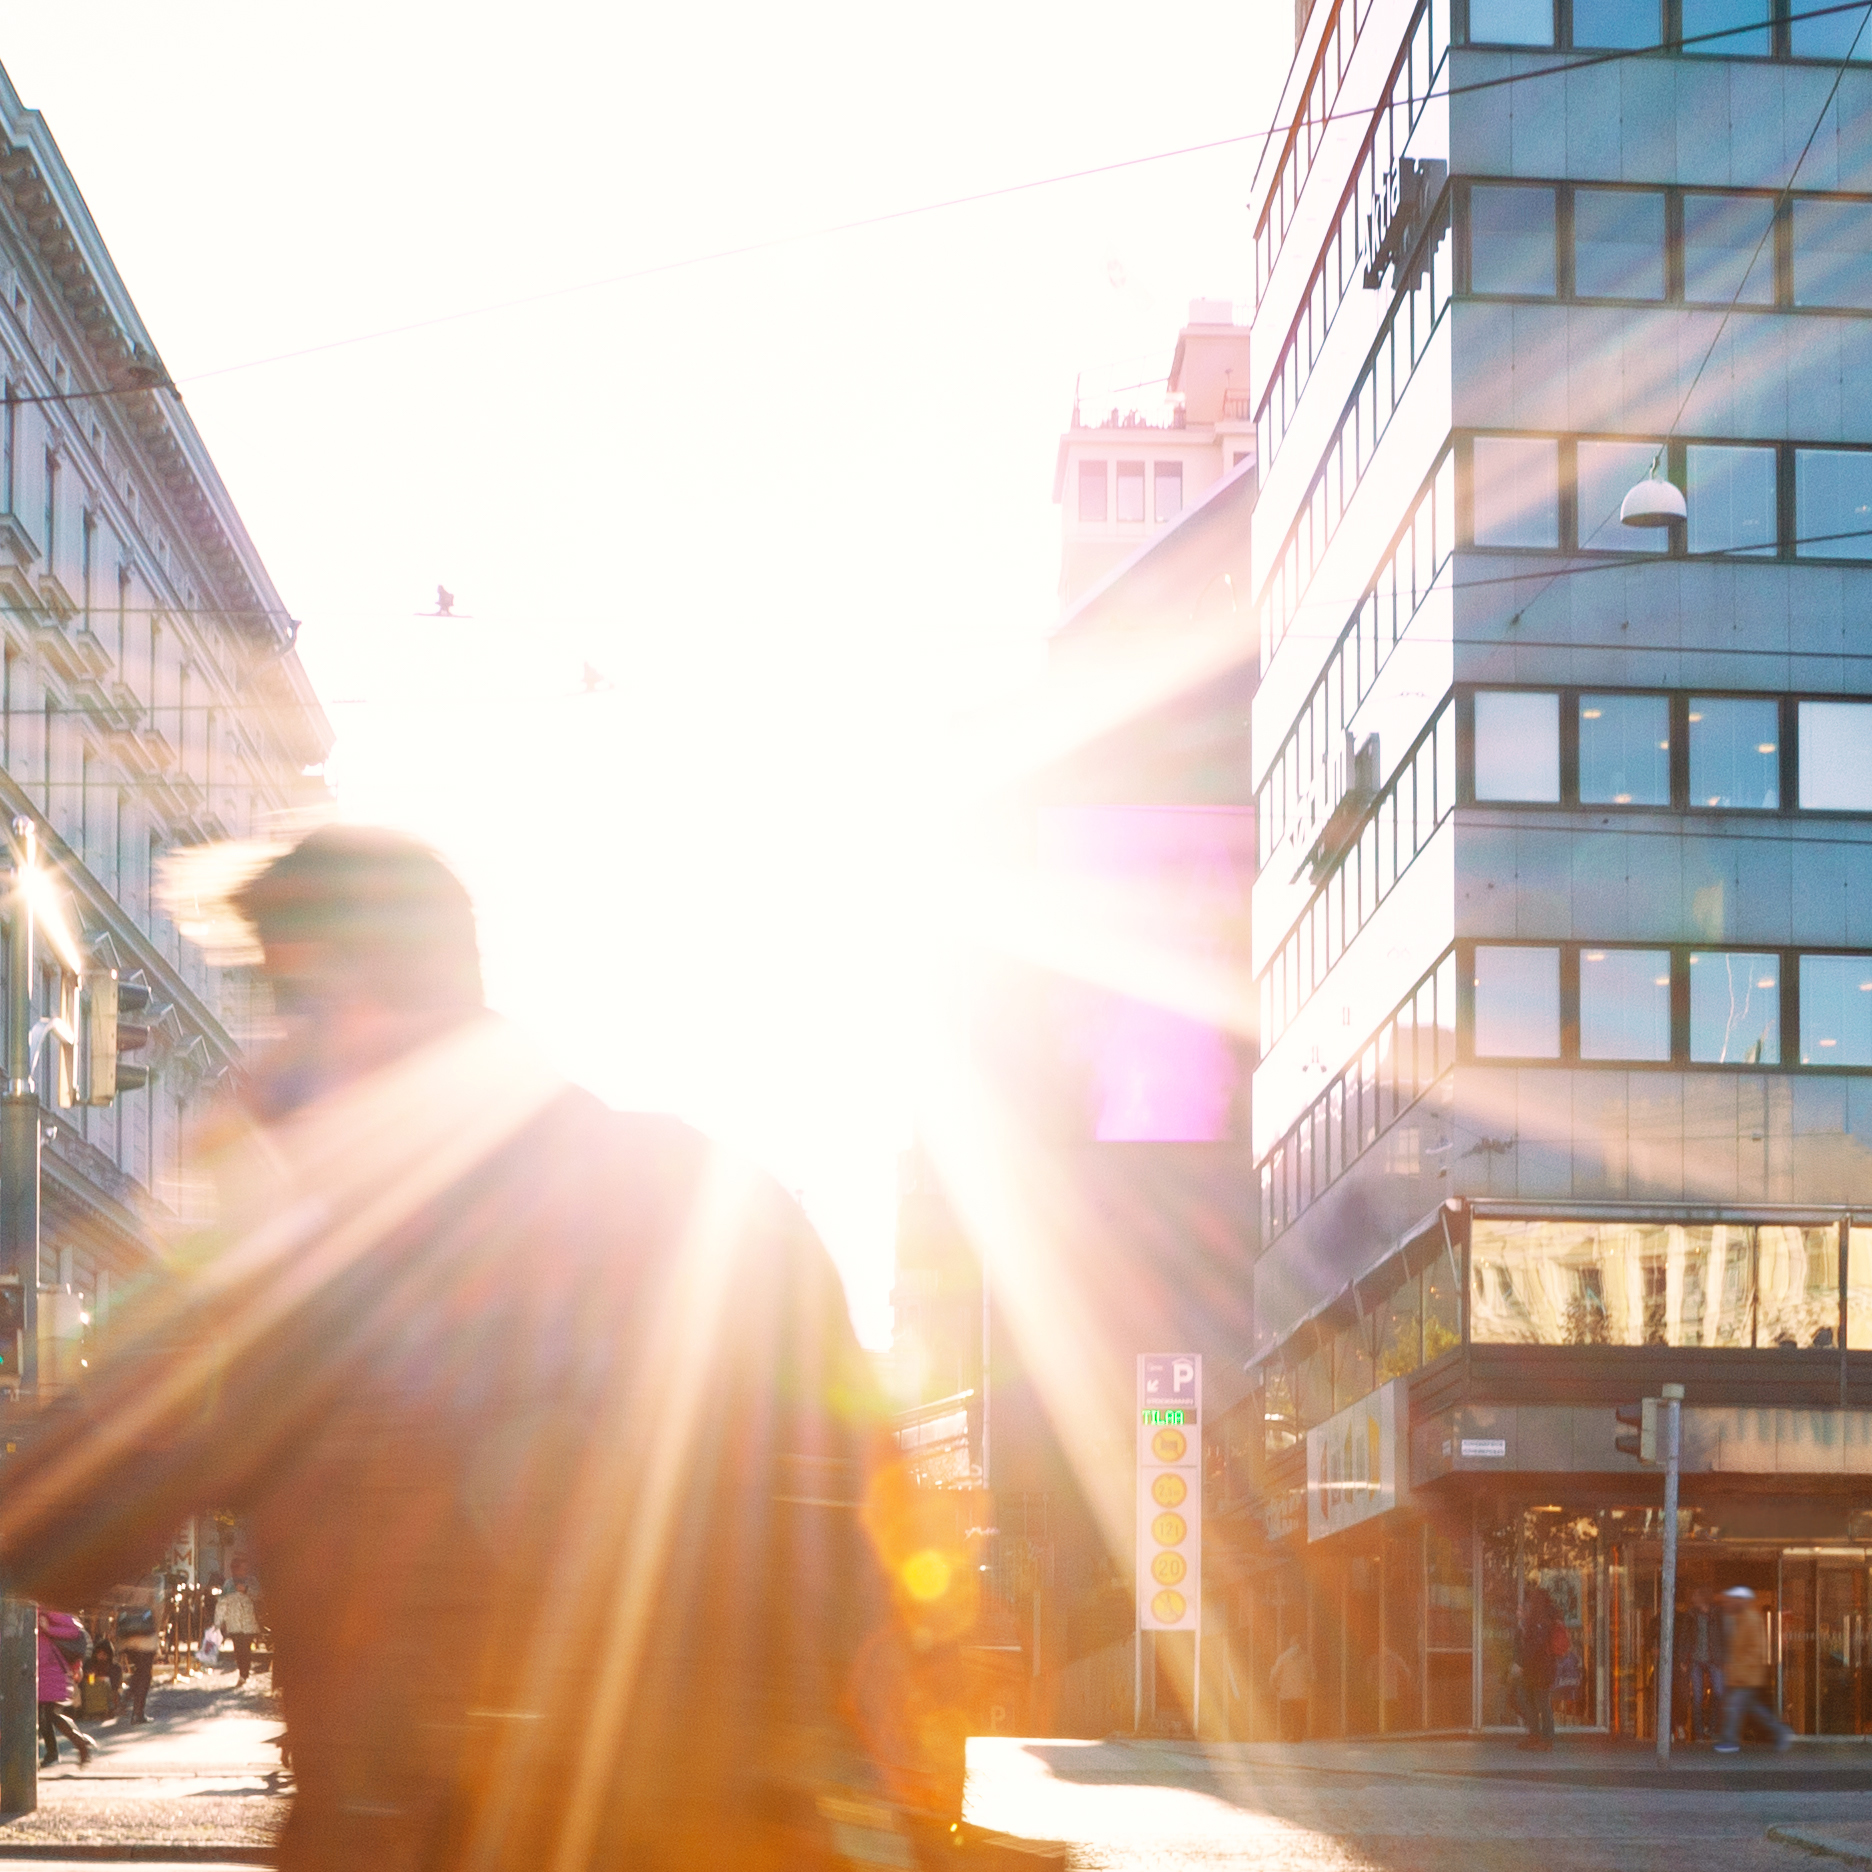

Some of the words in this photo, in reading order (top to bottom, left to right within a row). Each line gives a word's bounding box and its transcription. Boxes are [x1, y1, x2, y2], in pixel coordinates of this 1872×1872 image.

[1359, 157, 1401, 288] Aktia
[1173, 1363, 1194, 1393] P
[1141, 1409, 1185, 1426] TILAA
[1158, 1559, 1180, 1577] 20
